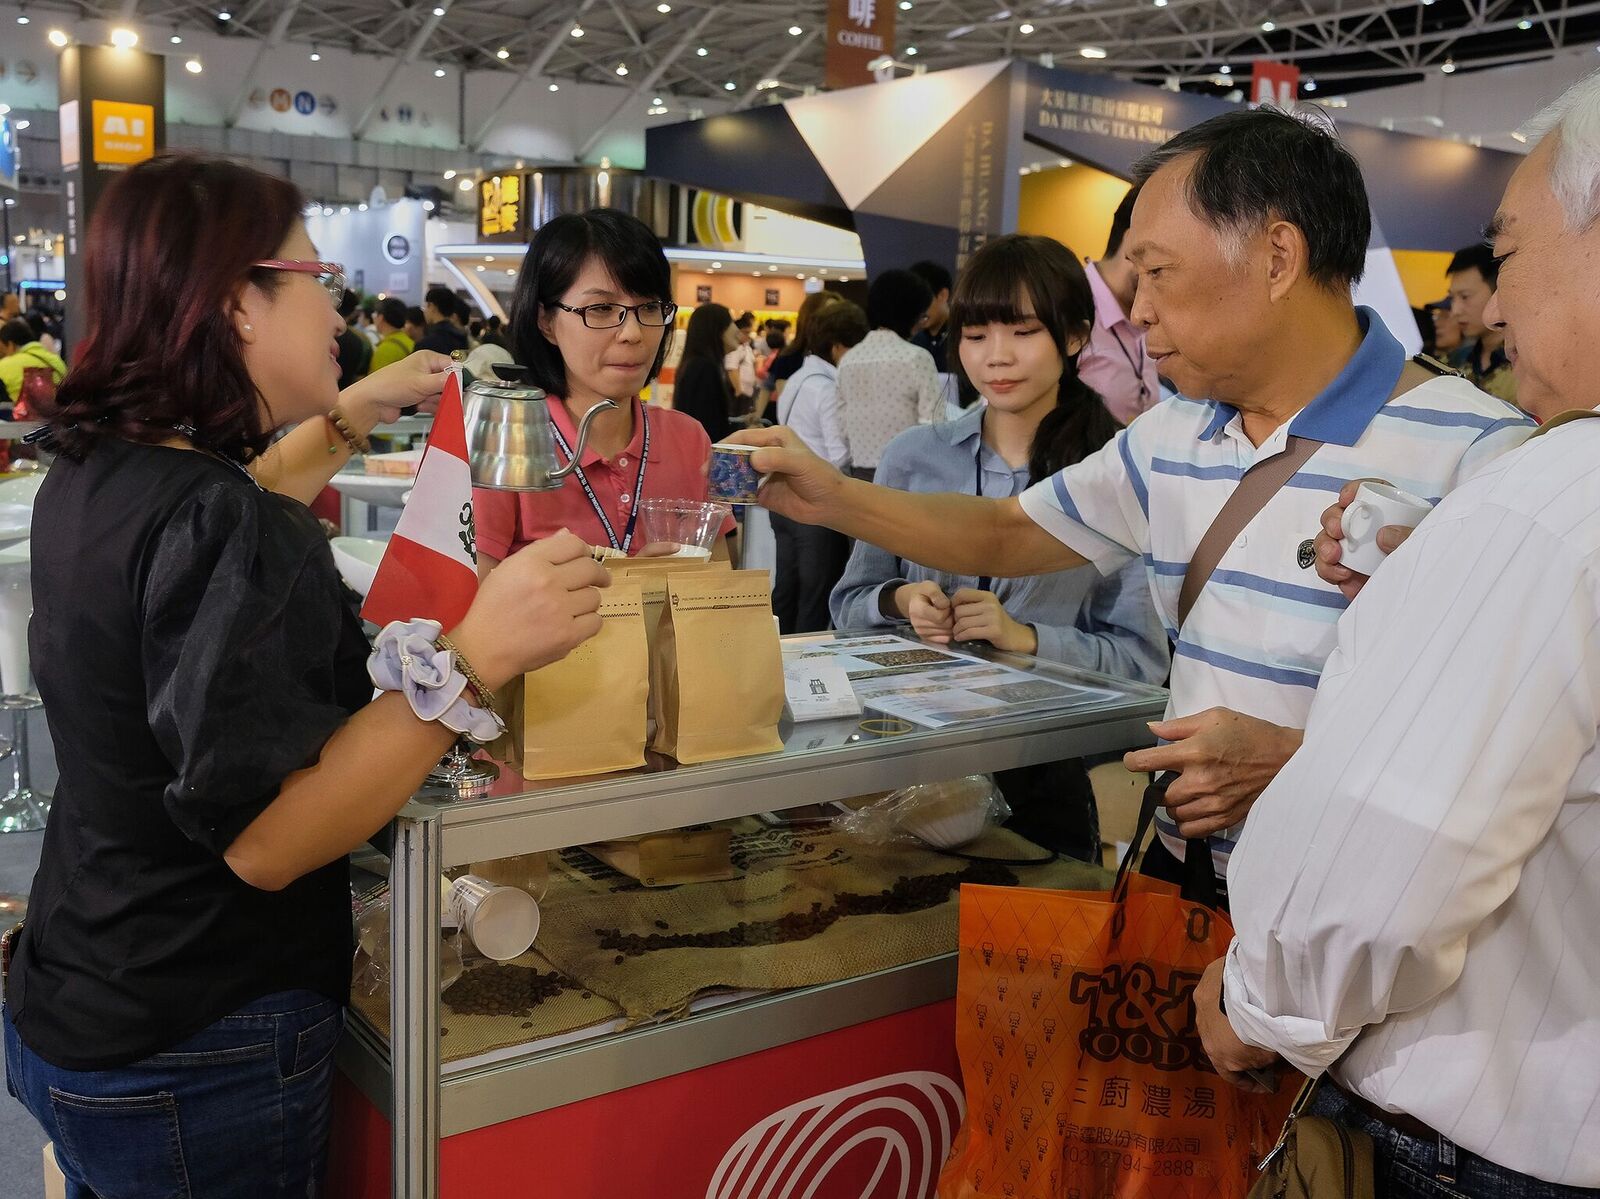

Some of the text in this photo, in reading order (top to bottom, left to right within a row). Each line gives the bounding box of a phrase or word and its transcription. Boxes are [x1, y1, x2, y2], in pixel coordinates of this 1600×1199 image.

[837, 30, 884, 51] COFFEE
[1038, 109, 1059, 129] DA
[1073, 1075, 1217, 1119] 三廚濃湯
